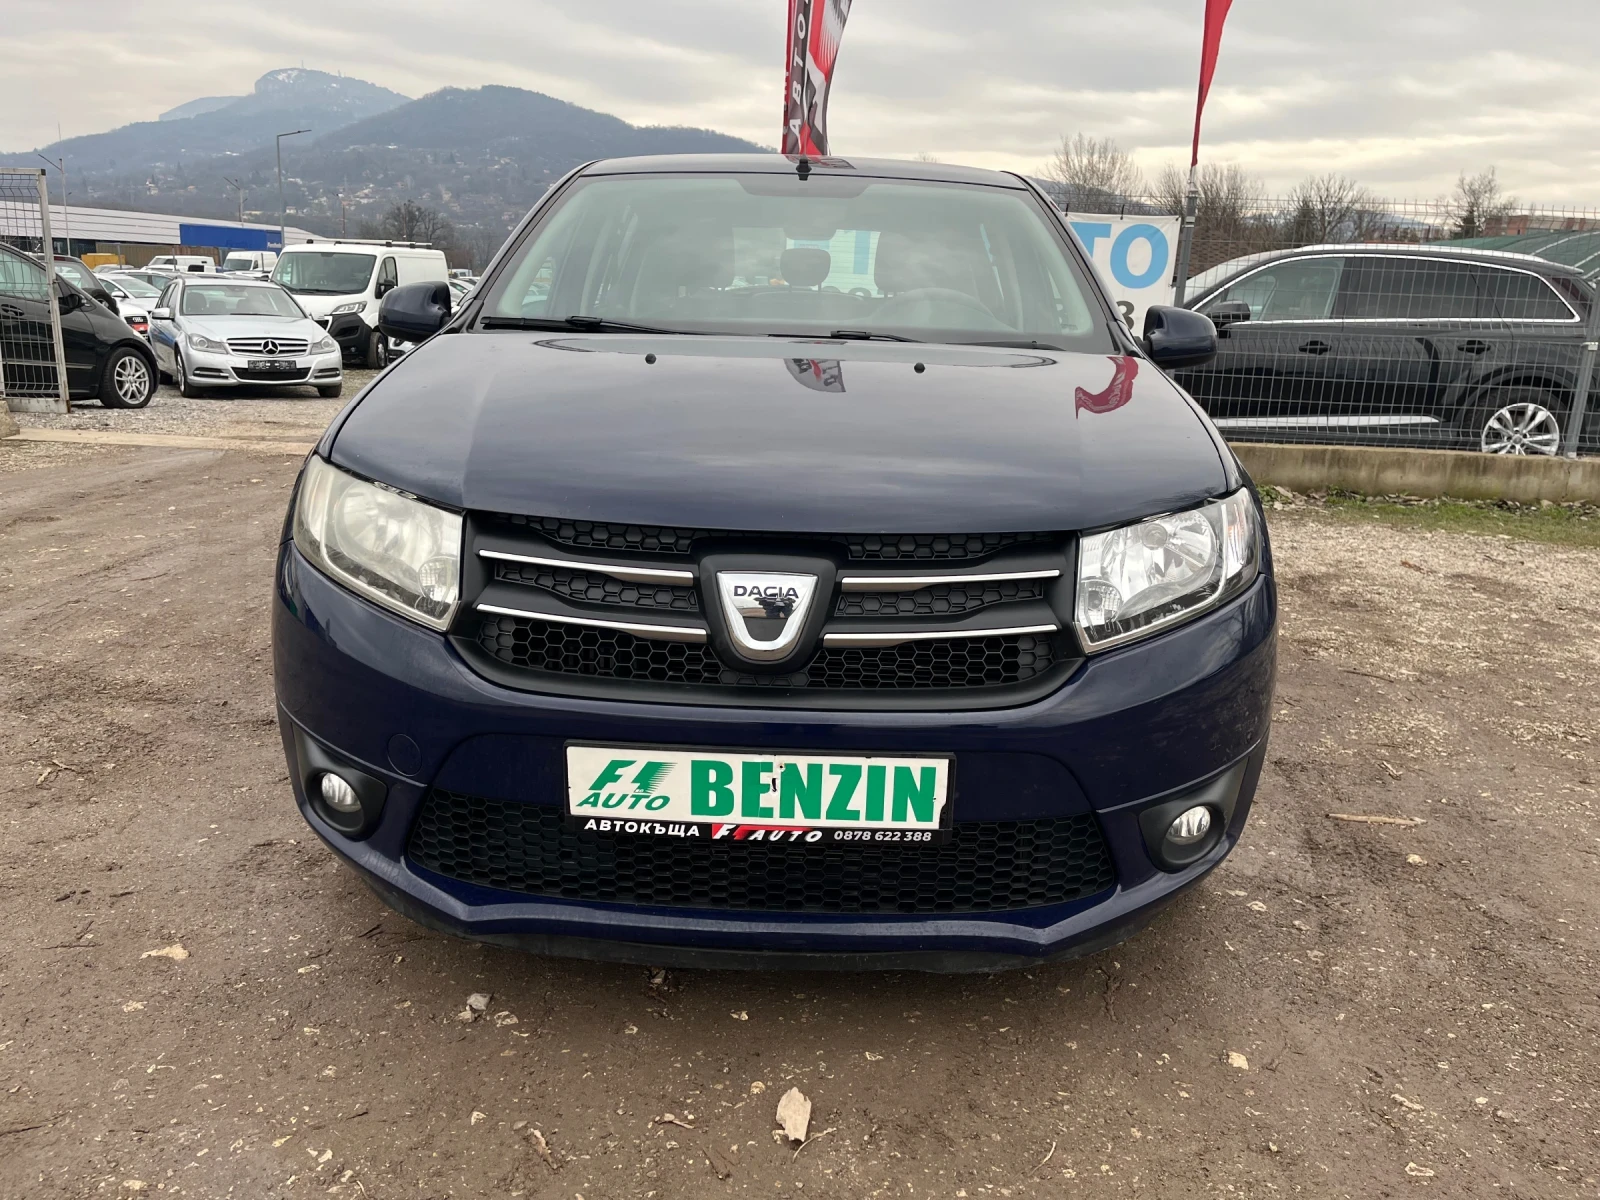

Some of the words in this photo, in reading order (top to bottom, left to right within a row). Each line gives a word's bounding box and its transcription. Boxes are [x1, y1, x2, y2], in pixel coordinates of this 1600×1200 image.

[789, 0, 808, 137] АВТО
[733, 585, 799, 598] DACIA
[575, 792, 671, 811] AUTO
[690, 759, 937, 822] BENZIN
[584, 819, 701, 838] АВТОКЪЩА
[747, 829, 823, 843] AUTO
[833, 830, 872, 841] 0878
[874, 831, 901, 842] 622
[903, 831, 932, 842] 388
